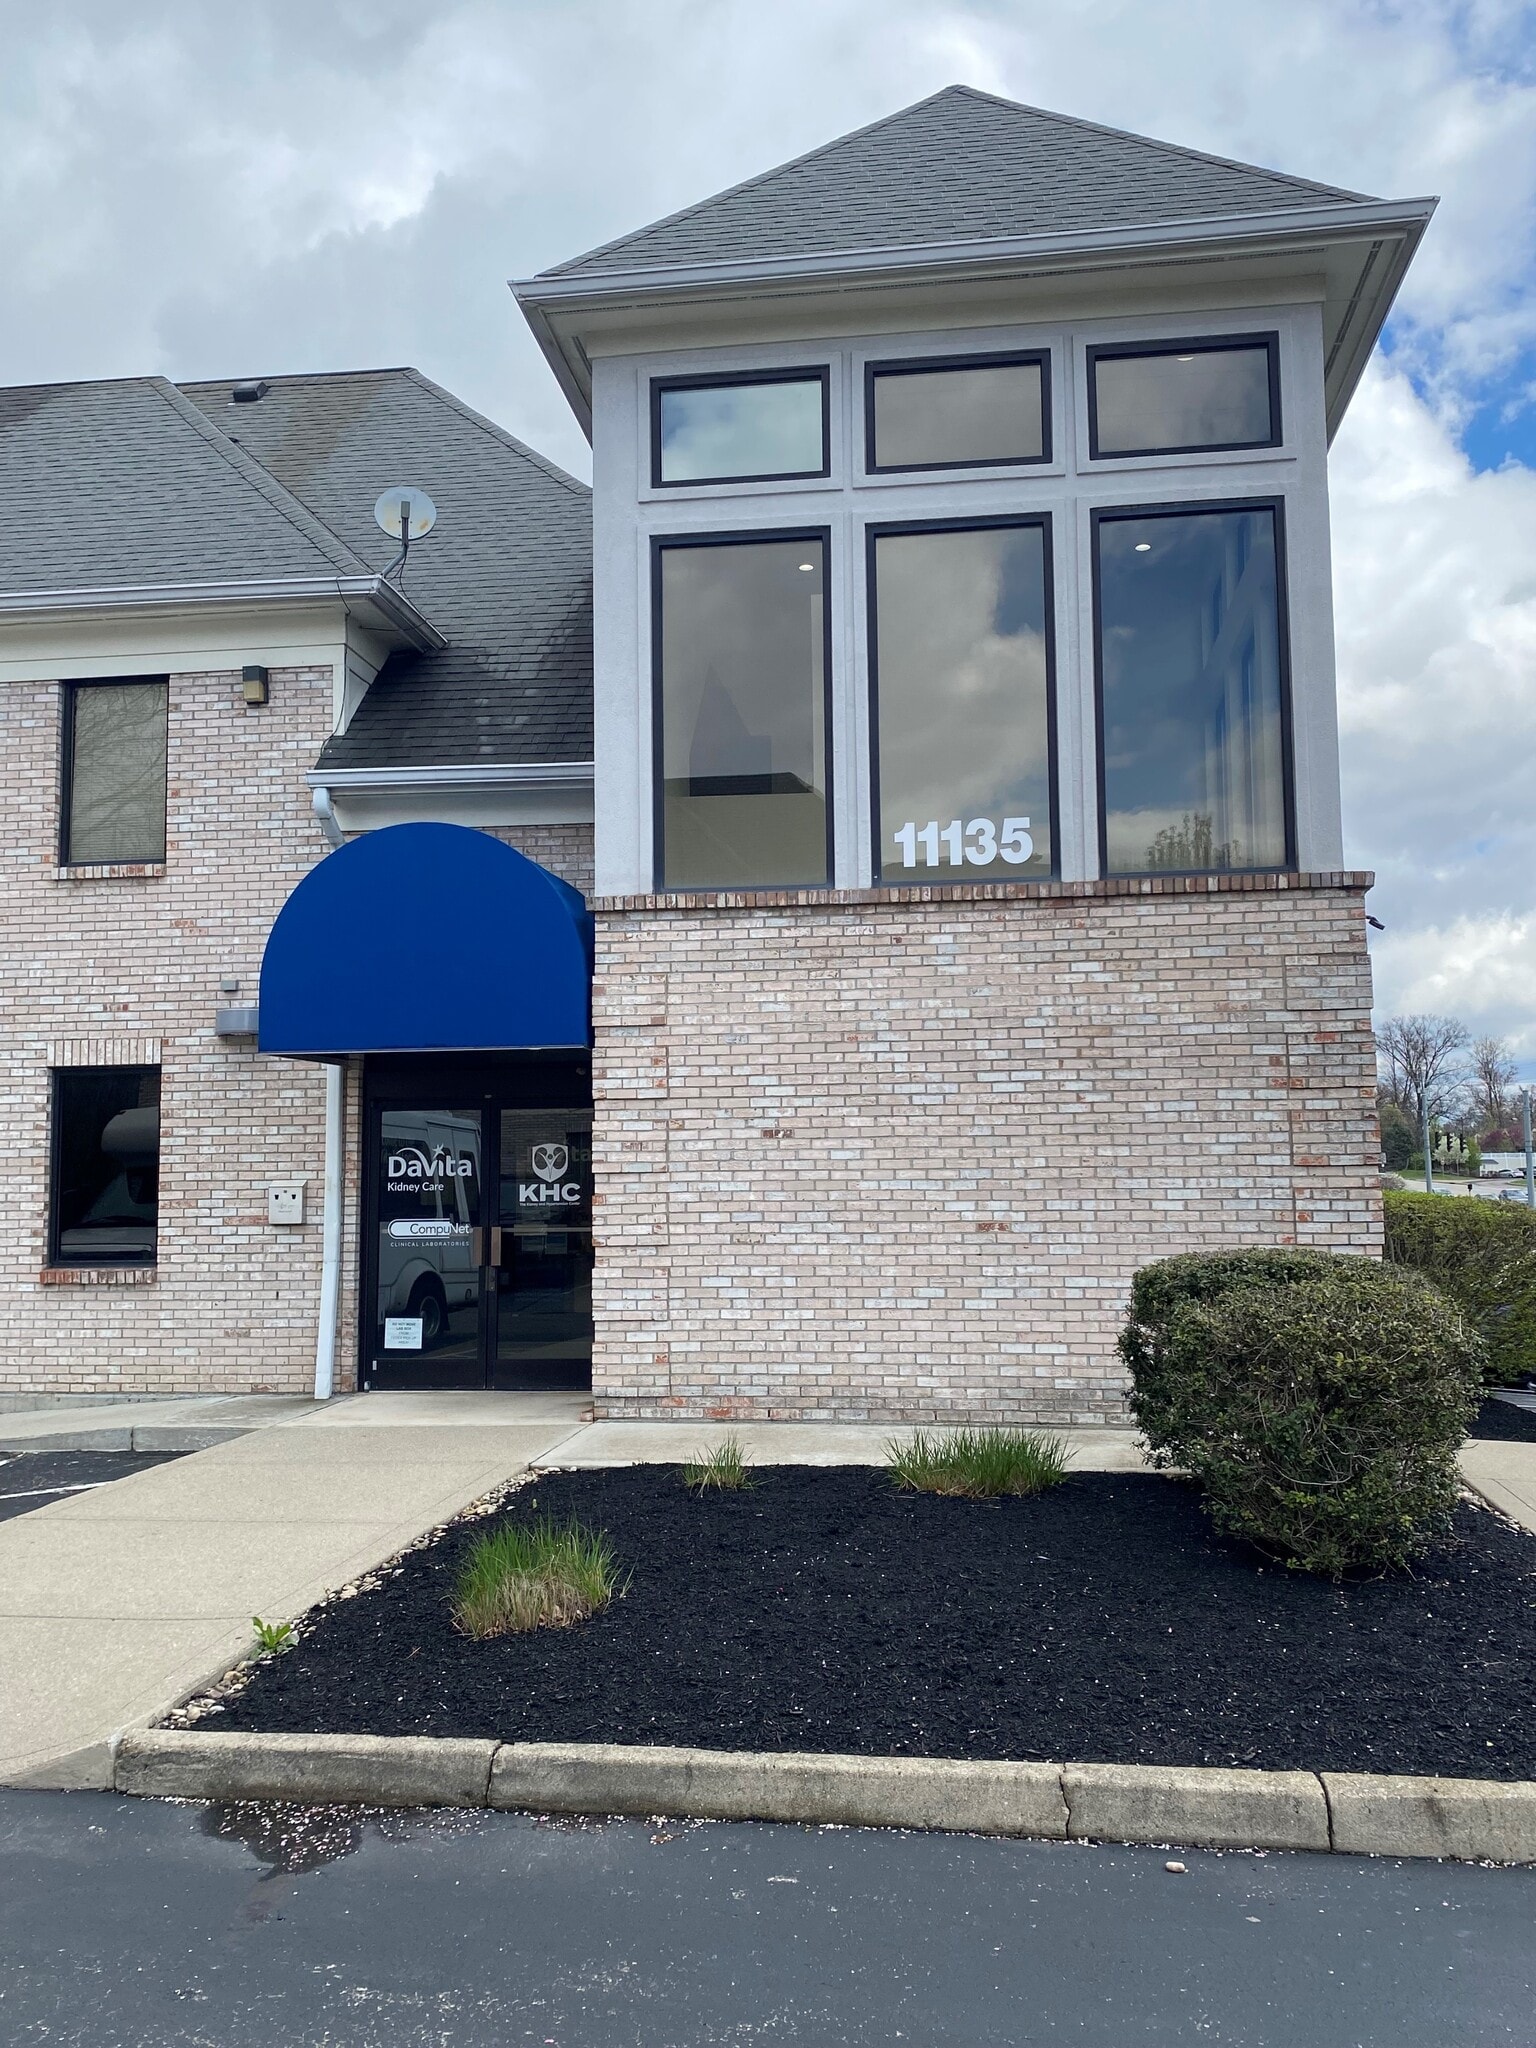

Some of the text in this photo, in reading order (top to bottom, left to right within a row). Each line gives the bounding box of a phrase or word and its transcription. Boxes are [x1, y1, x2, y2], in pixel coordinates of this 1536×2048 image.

[894, 817, 1034, 868] 11135
[388, 1145, 472, 1177] DaVita
[387, 1182, 444, 1193] Kidney Care
[519, 1183, 581, 1202] KHC
[410, 1223, 470, 1235] CompuNet
